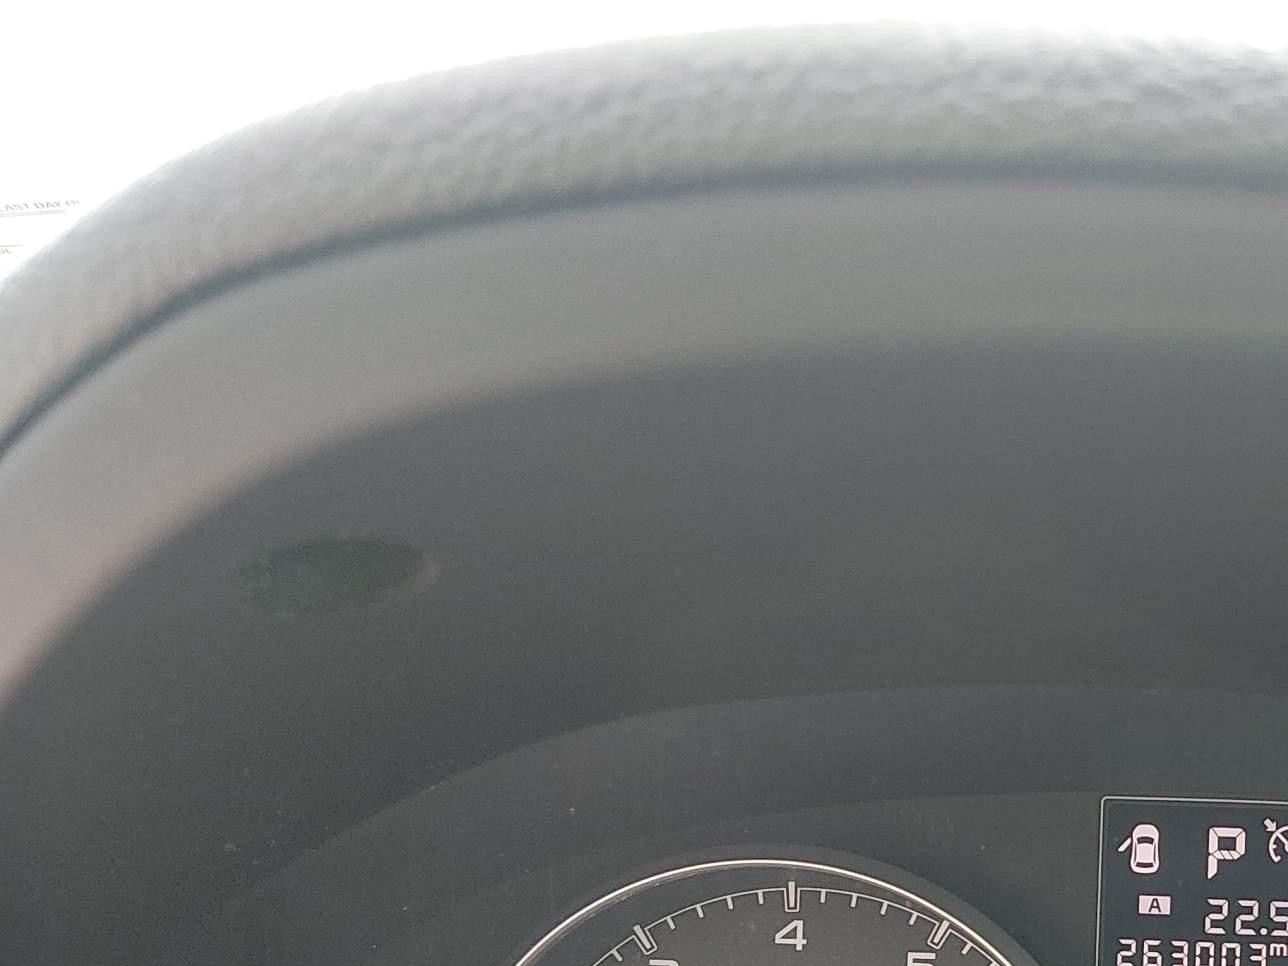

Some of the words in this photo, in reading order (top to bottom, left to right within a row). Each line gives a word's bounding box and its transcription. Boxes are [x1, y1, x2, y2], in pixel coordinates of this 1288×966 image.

[1208, 828, 1245, 879] P
[1148, 898, 1162, 913] A
[775, 920, 807, 950] 4
